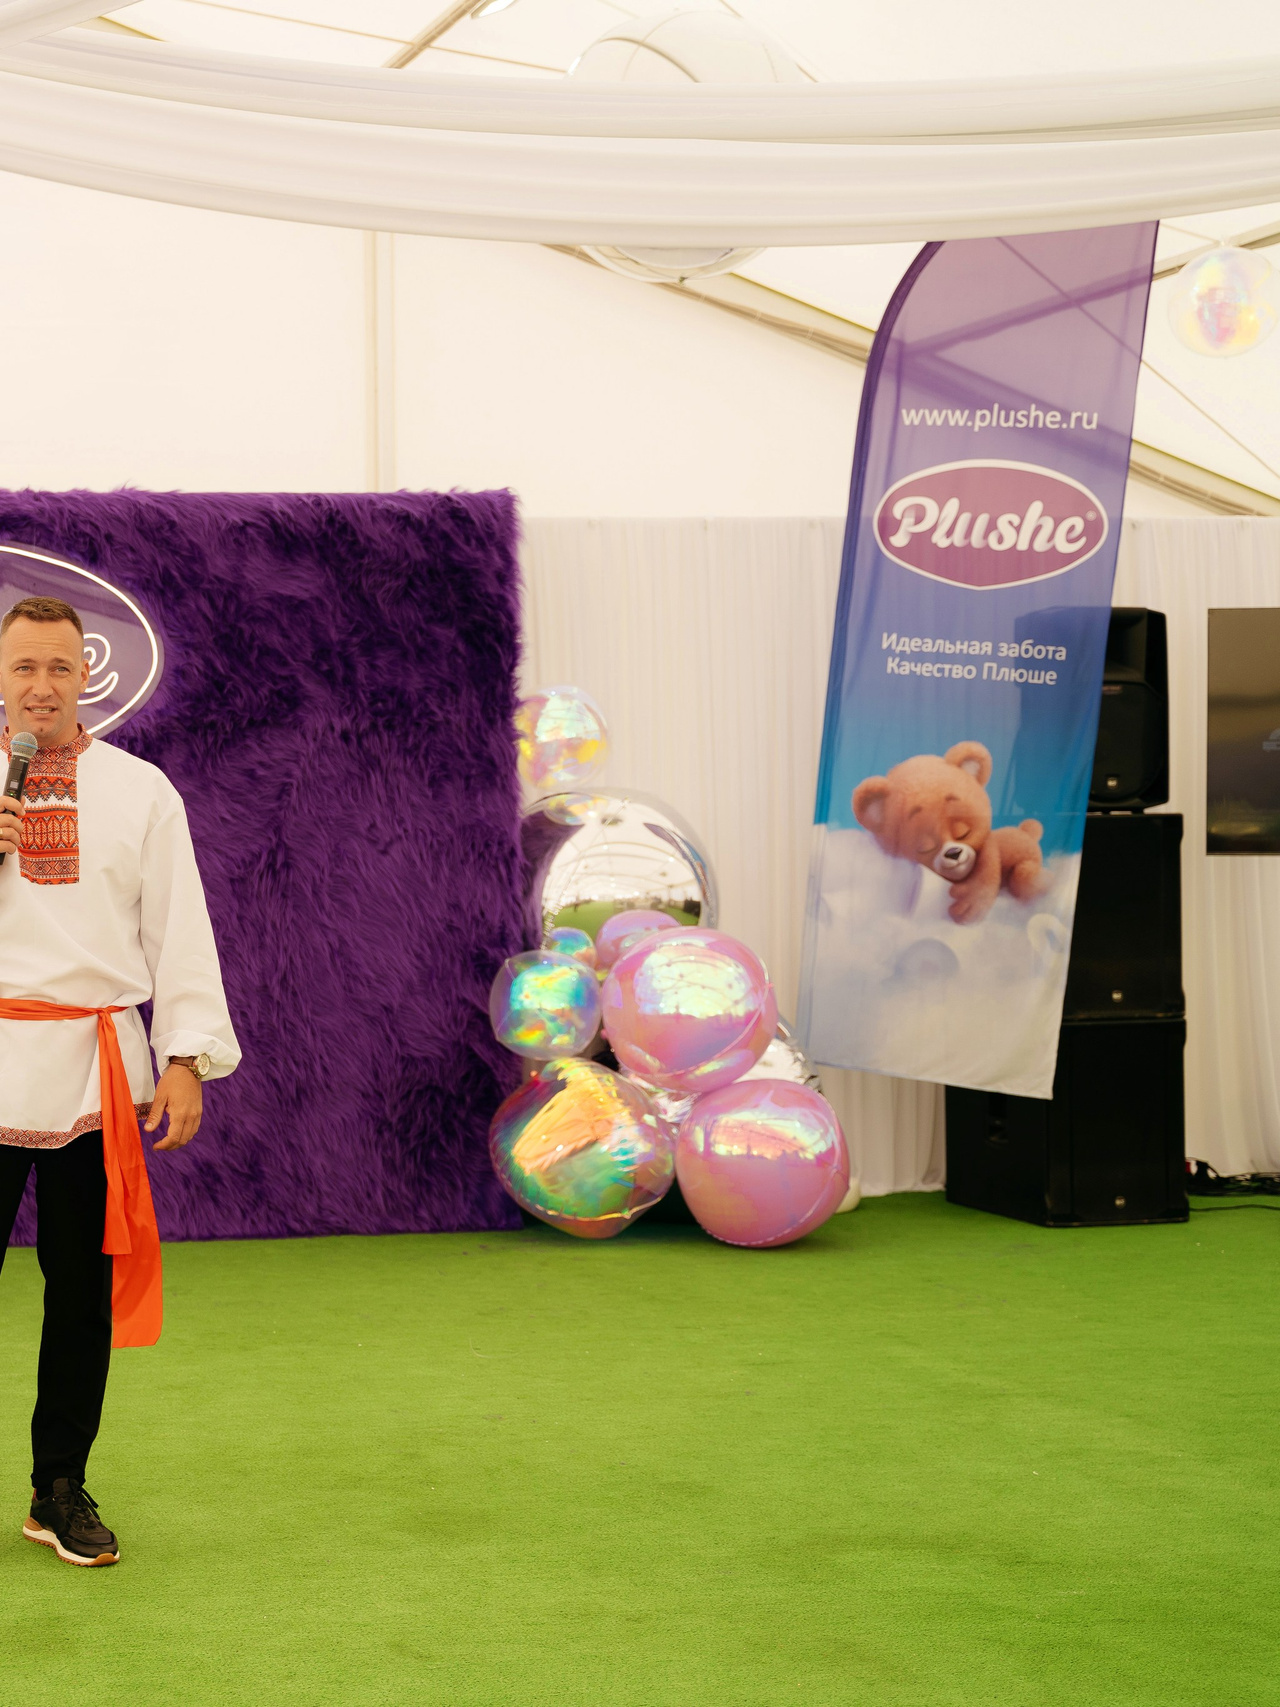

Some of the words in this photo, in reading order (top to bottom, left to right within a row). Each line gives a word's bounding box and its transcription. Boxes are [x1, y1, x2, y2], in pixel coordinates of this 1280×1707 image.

[901, 402, 1098, 432] www.plushe.ru
[889, 496, 1087, 554] Plushe
[881, 632, 993, 655] Идеальная
[997, 639, 1067, 660] забота
[886, 656, 977, 679] Качество
[982, 661, 1058, 685] Плюше
